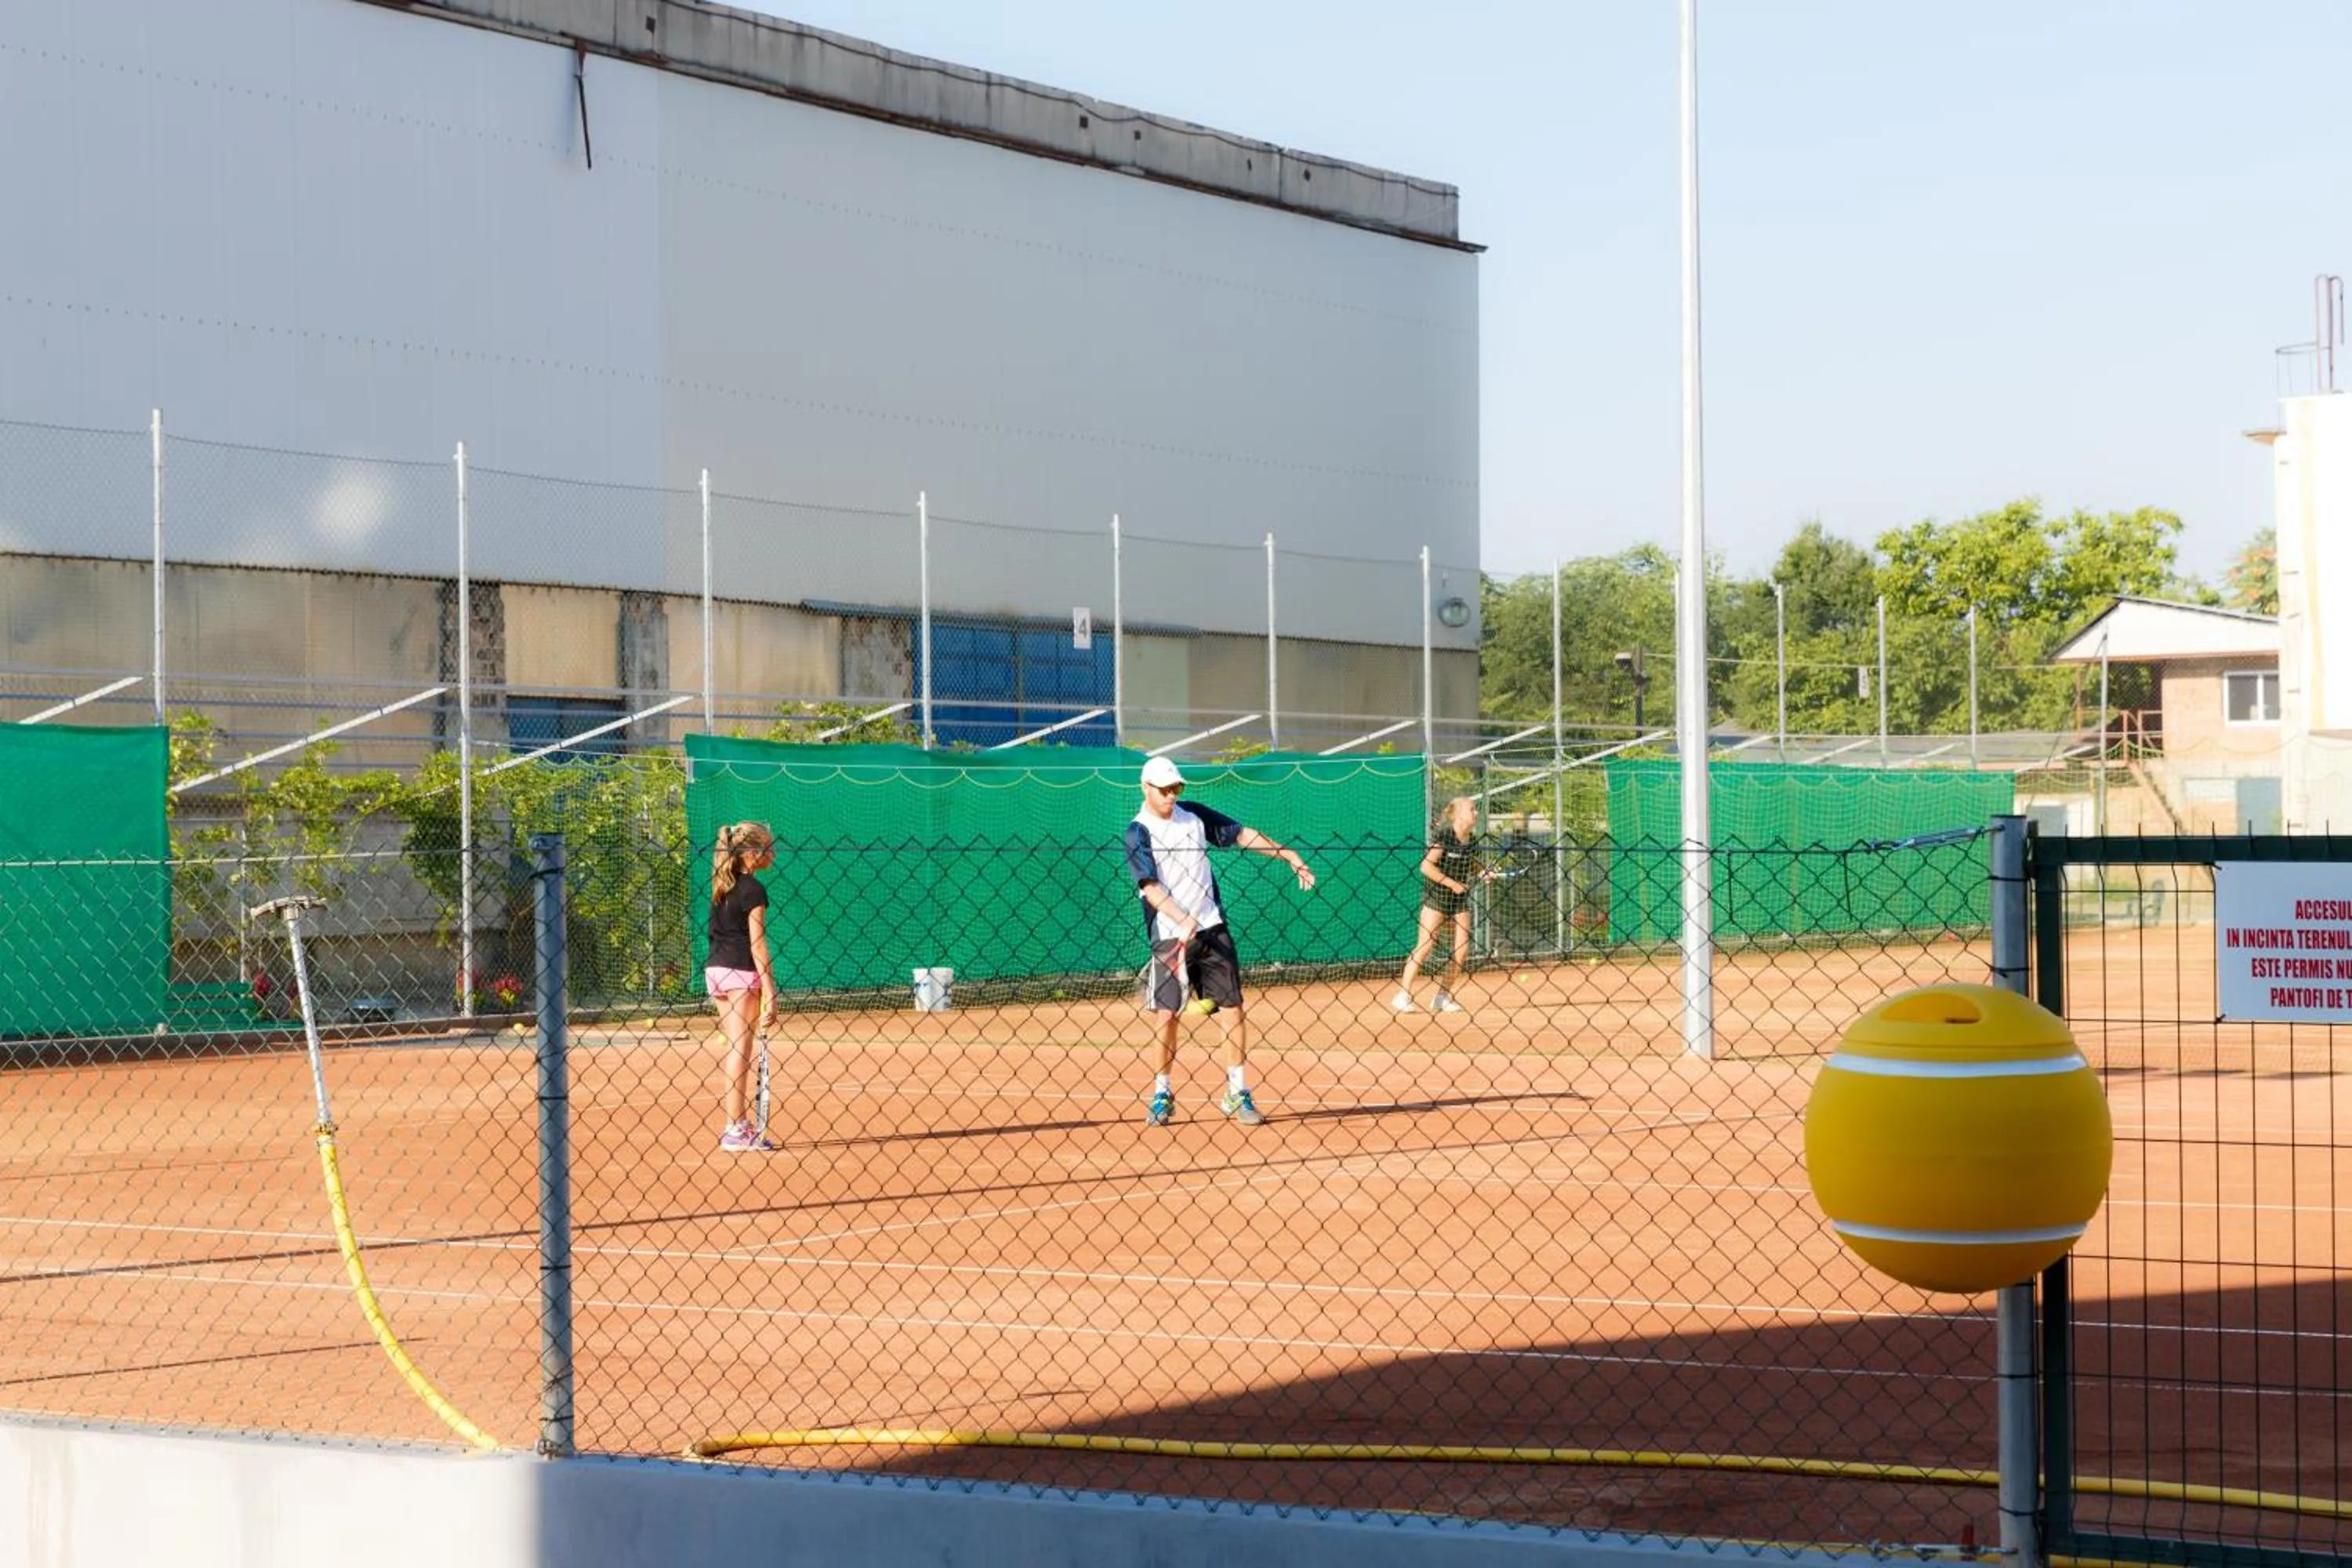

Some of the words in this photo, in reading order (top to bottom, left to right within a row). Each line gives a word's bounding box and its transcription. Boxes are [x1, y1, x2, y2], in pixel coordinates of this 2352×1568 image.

[1078, 618, 1087, 639] 4
[2295, 900, 2352, 920] ACCESUL
[2227, 928, 2240, 948] IN
[2243, 928, 2294, 949] INCINTA
[2252, 958, 2281, 978] ESTE
[2285, 959, 2333, 978] PERMIS
[2270, 988, 2323, 1007] PANTOFI
[2327, 989, 2343, 1008] DE
